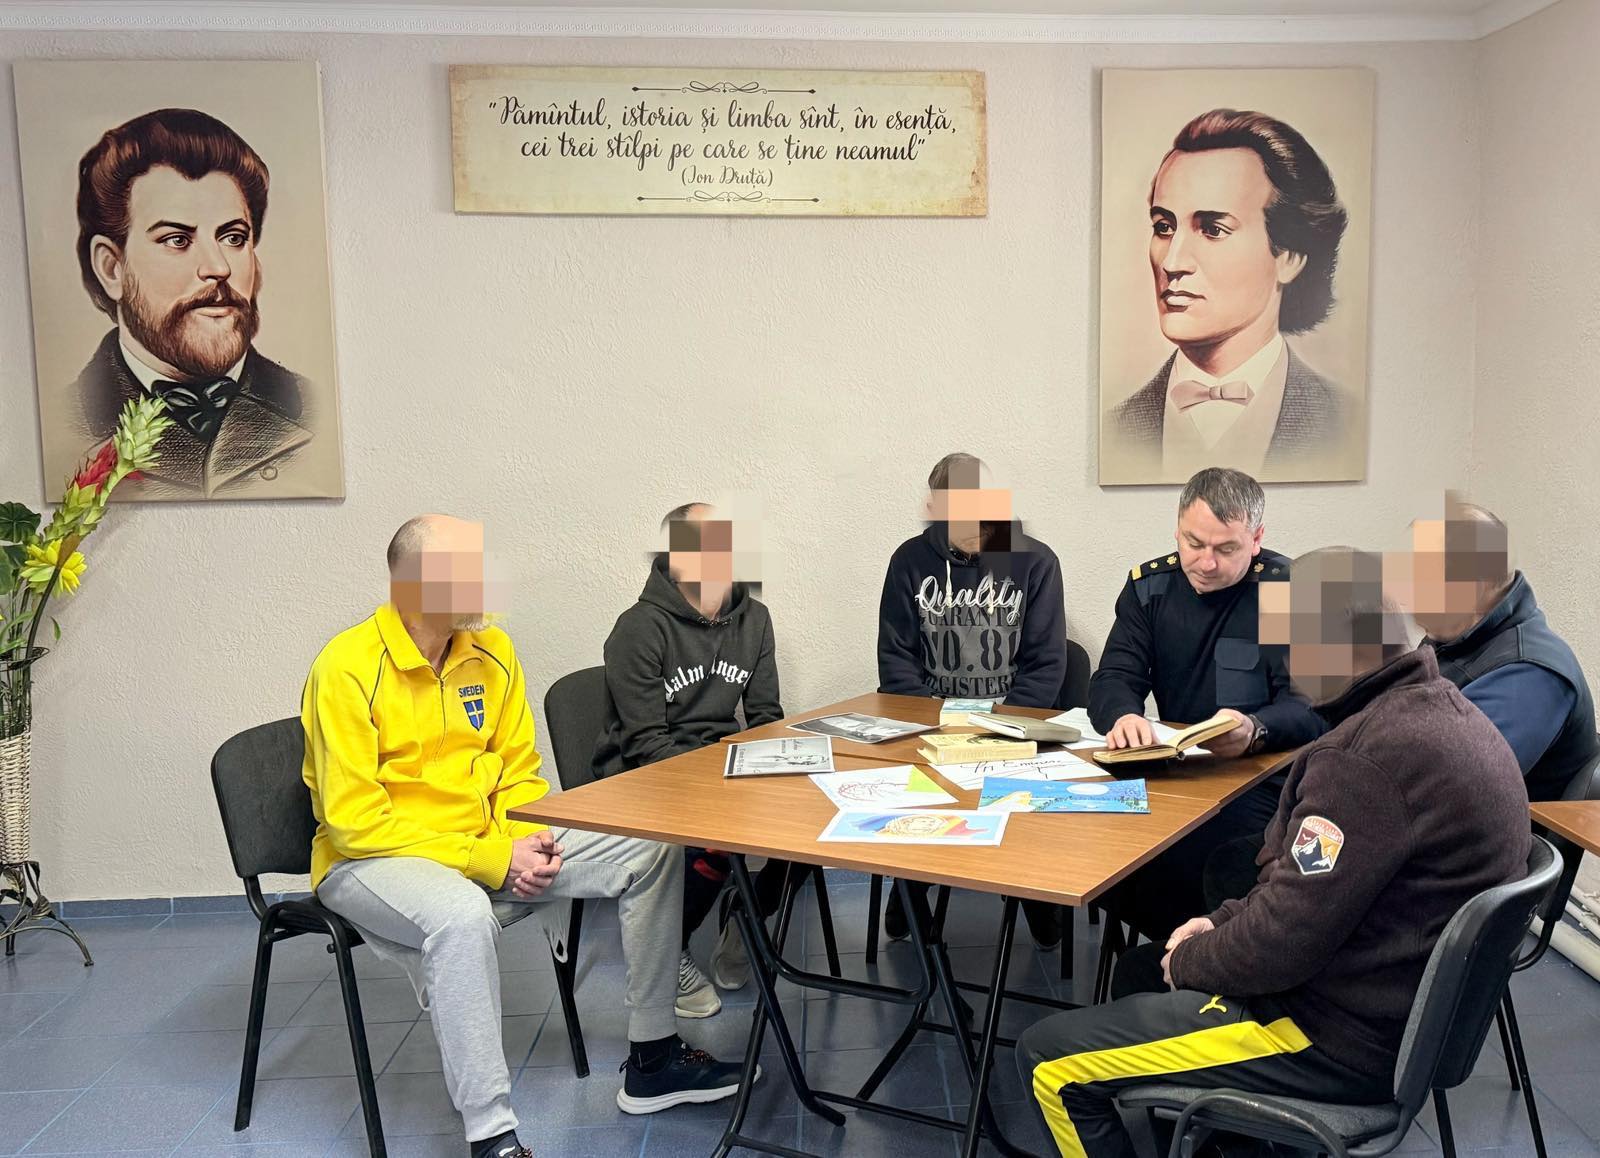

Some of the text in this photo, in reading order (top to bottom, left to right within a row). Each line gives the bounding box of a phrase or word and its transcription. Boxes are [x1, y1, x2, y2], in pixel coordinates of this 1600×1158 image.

[622, 100, 693, 127] istoria
[701, 106, 719, 134] și
[727, 99, 792, 129] limba
[799, 103, 844, 133] sînt,
[854, 106, 878, 130] în
[885, 104, 956, 135] esență,
[520, 136, 551, 158] cei
[557, 131, 599, 158] trei
[667, 143, 695, 172] pe
[702, 139, 750, 161] care
[758, 139, 778, 161] se
[784, 134, 828, 166] ține
[718, 164, 774, 189] Druță)
[914, 574, 1024, 626] Quality
[458, 684, 485, 698] SWEDEN
